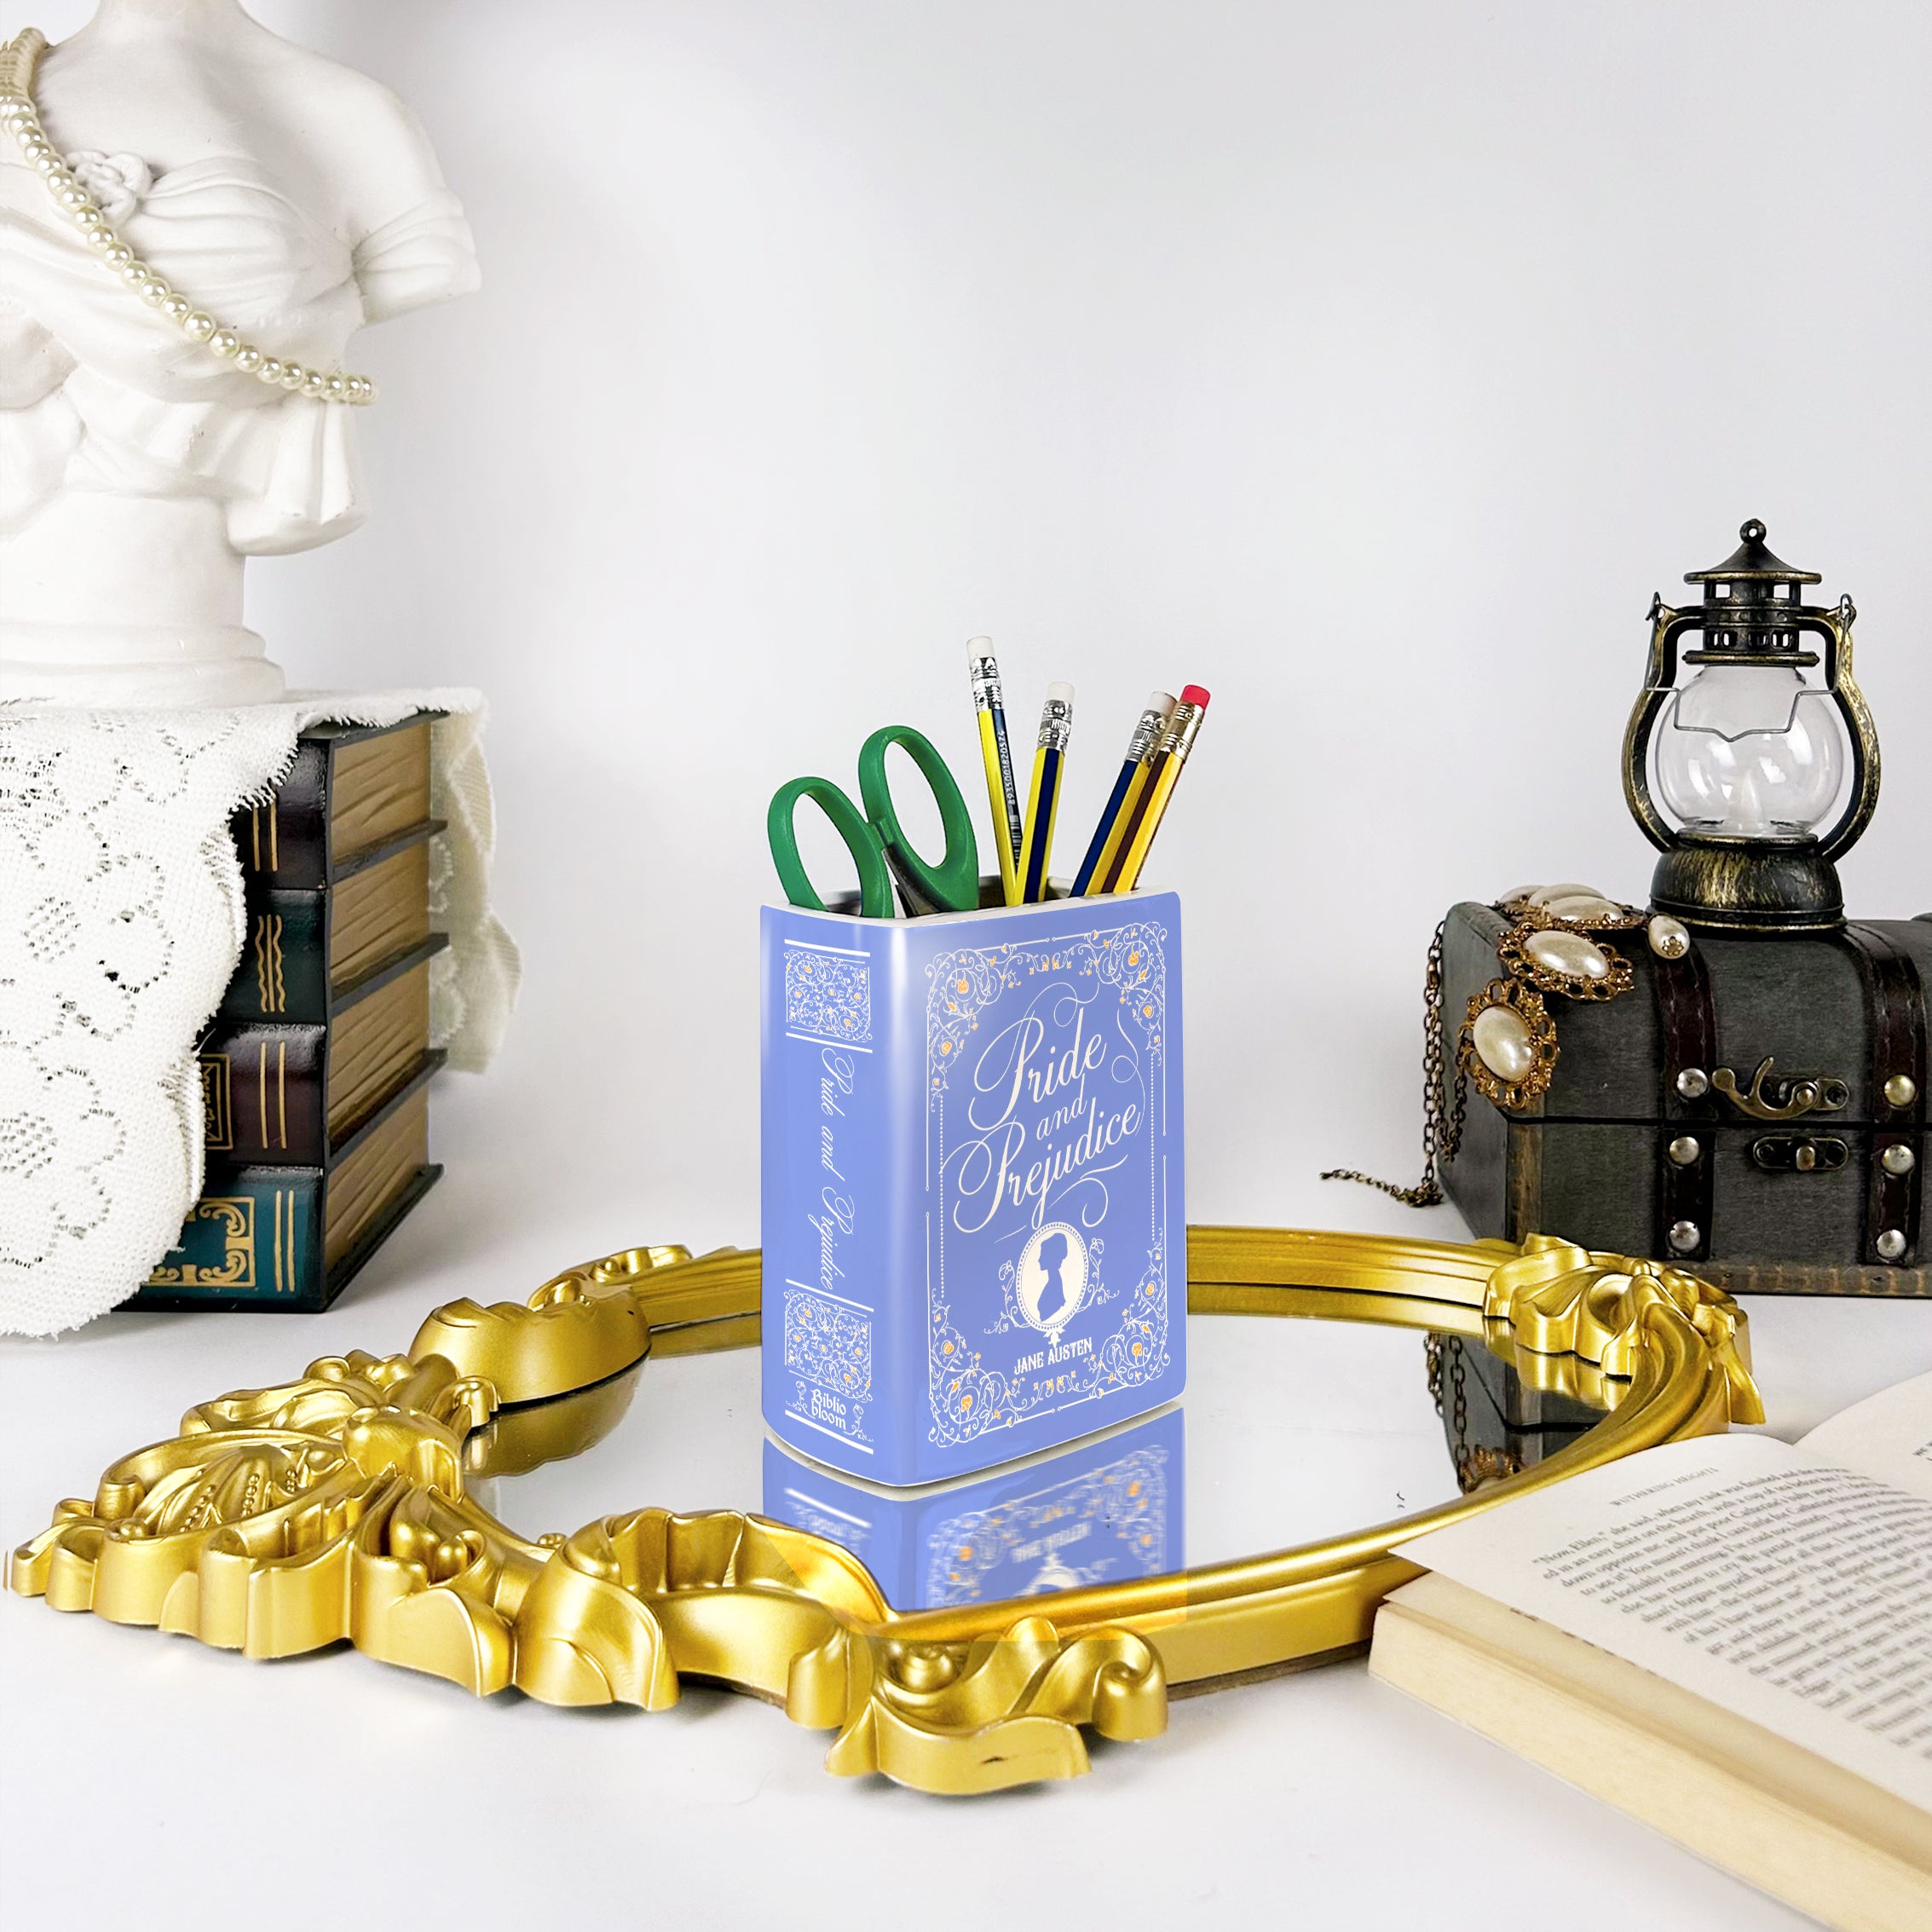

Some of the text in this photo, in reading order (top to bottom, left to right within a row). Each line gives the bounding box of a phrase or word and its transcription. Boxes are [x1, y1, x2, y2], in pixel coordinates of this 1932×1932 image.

[968, 984, 1107, 1132] Pride
[1036, 1074, 1089, 1141] and
[808, 1047, 857, 1291] Pride and Prejudice
[943, 1096, 1142, 1233] Prejudice
[1013, 1336, 1093, 1376] JANE AUSTEN
[810, 1388, 847, 1416] Biblio
[811, 1399, 847, 1430] bloom
[1588, 1548, 1615, 1560] easy
[1612, 1536, 1642, 1550] chair
[1711, 1500, 1739, 1511] with
[1629, 1514, 1660, 1528] said,
[1654, 1505, 1687, 1518] when
[1699, 1491, 1725, 1502] task
[1739, 1474, 1782, 1488] finished
[1690, 1535, 1722, 1550] think
[1727, 1526, 1751, 1537] care
[1743, 1517, 1775, 1530] little
[1785, 1499, 1837, 1514] Catherine
[1560, 1571, 1597, 1587] down
[1595, 1551, 1645, 1573] opposite
[1705, 1516, 1733, 1530] poor
[1782, 1492, 1815, 1502] baby
[1811, 1487, 1838, 1496] away
[1612, 1575, 1667, 1599] foolishly
[1745, 1531, 1774, 1545] cried
[1787, 1514, 1831, 1529] bitterly
[1620, 1601, 1647, 1613] else
[1667, 1577, 1706, 1595] reason
[1759, 1538, 1797, 1557] parted
[1661, 1618, 1693, 1632] with
[1735, 1584, 1773, 1600] brute
[1821, 1555, 1846, 1568] give
[1673, 1589, 1718, 1608] forgive
[1720, 1611, 1754, 1624] have
